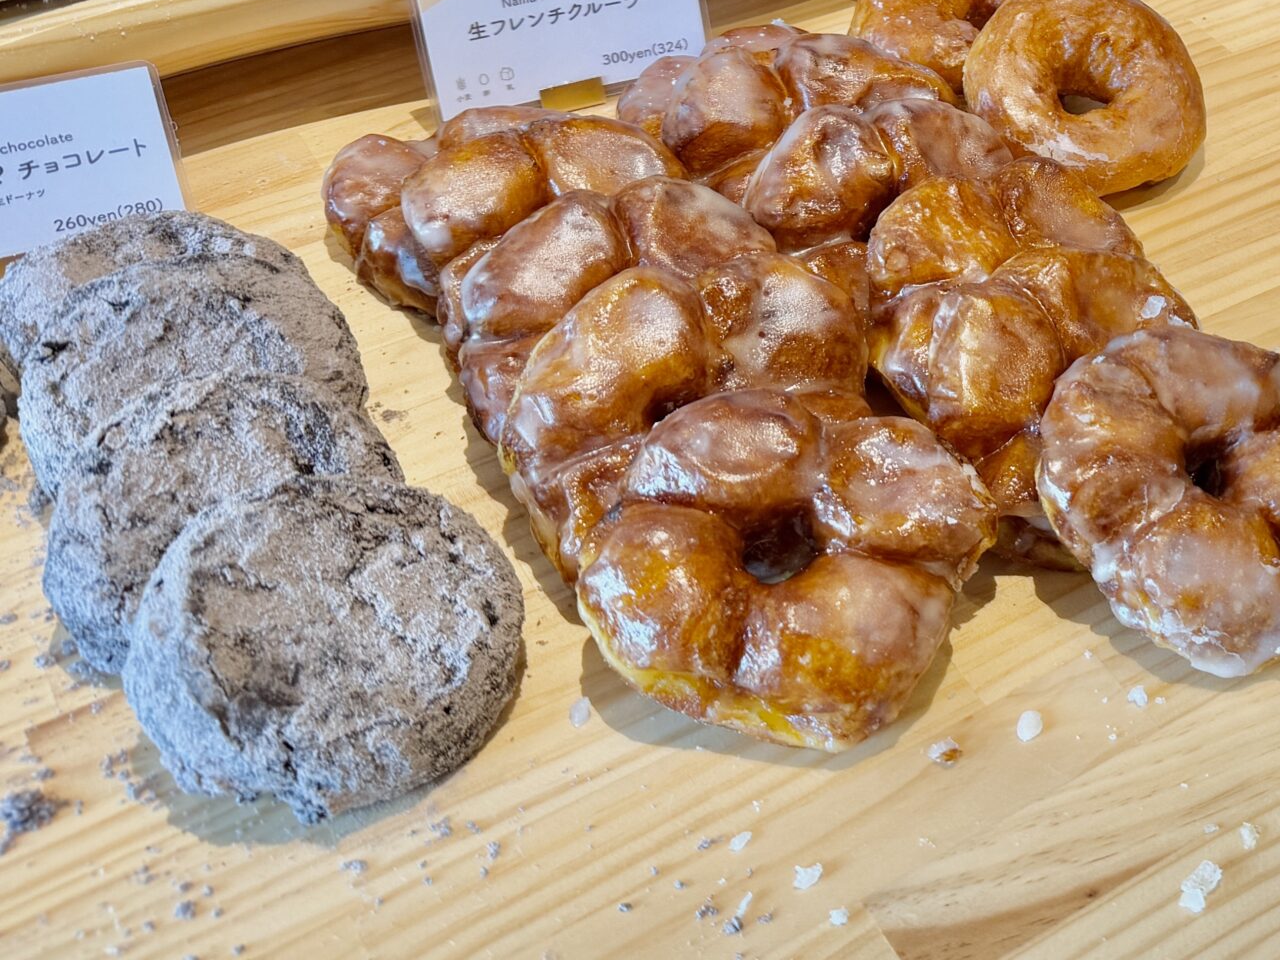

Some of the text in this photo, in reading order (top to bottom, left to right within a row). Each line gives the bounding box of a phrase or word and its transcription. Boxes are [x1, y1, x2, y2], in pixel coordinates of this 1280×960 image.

[602, 38, 689, 66] 300yen(324)
[18, 138, 147, 181] チョコレート
